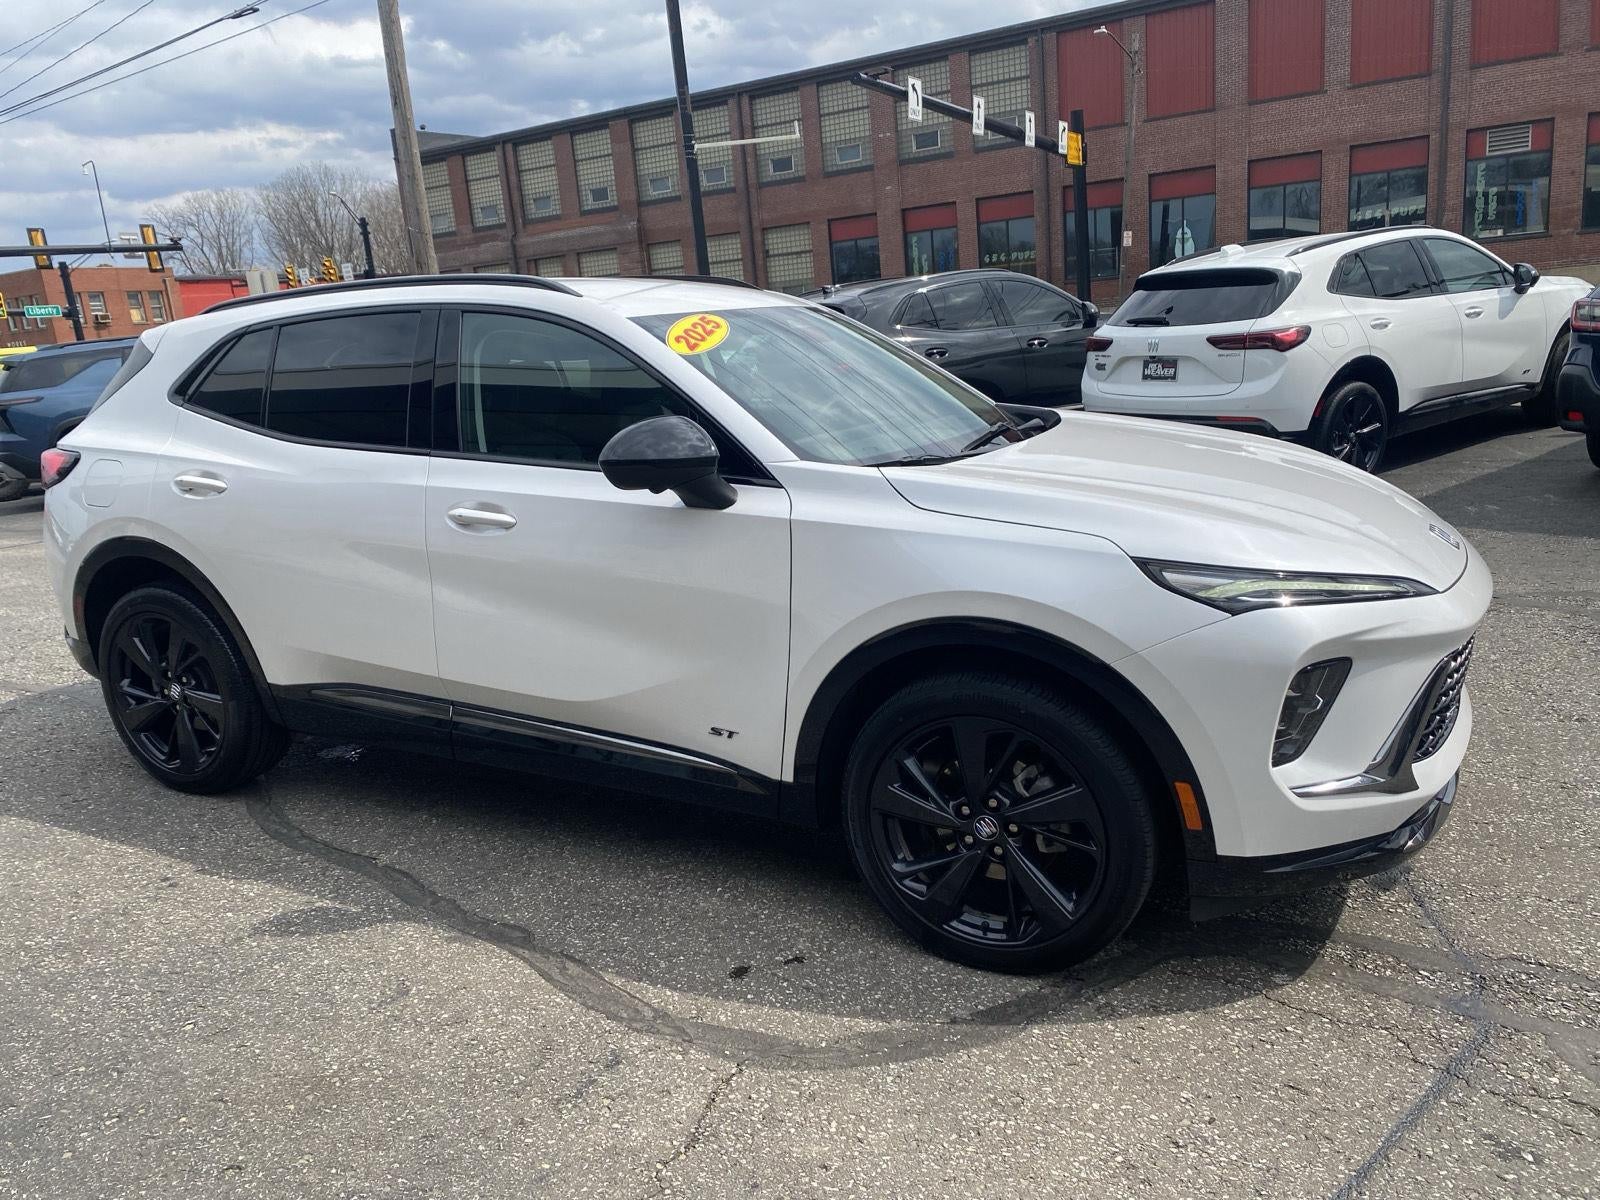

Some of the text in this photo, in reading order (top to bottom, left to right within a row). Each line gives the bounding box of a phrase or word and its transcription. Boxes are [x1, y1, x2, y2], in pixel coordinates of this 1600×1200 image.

[28, 307, 57, 315] Liberty
[674, 315, 721, 351] 2025
[1144, 367, 1175, 375] WEAVER
[708, 727, 739, 739] ST
